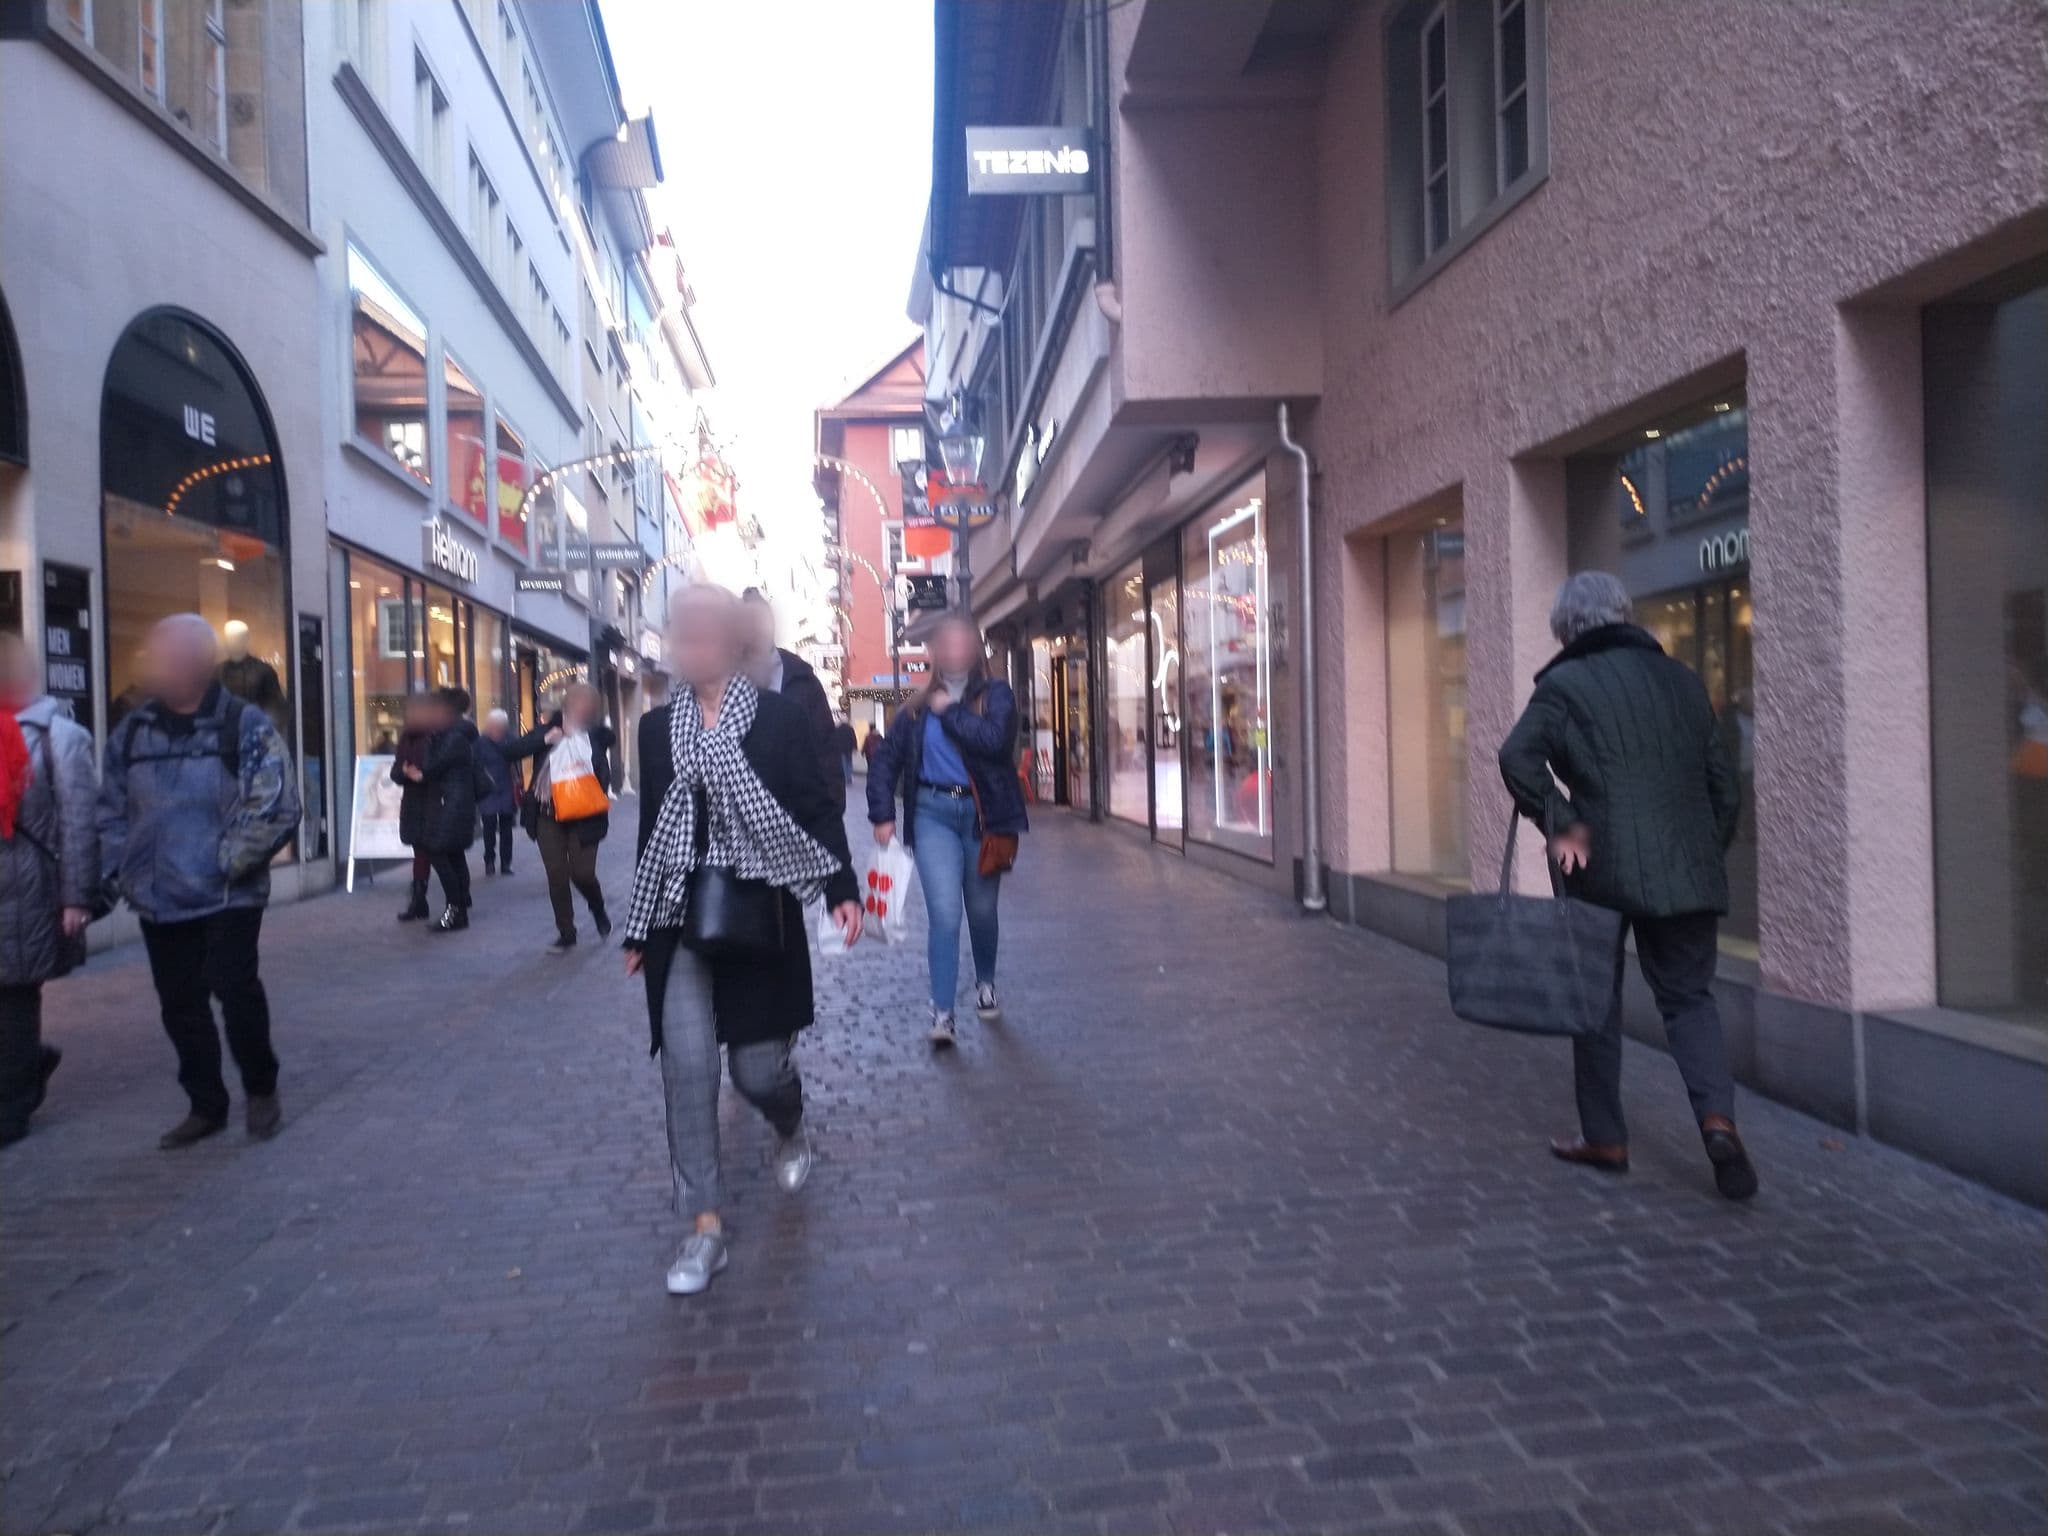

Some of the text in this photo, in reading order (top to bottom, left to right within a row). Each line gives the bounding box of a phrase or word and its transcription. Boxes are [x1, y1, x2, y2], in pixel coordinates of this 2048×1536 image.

[184, 404, 216, 447] WE
[48, 626, 70, 655] MEN
[48, 661, 86, 691] WOMEN
